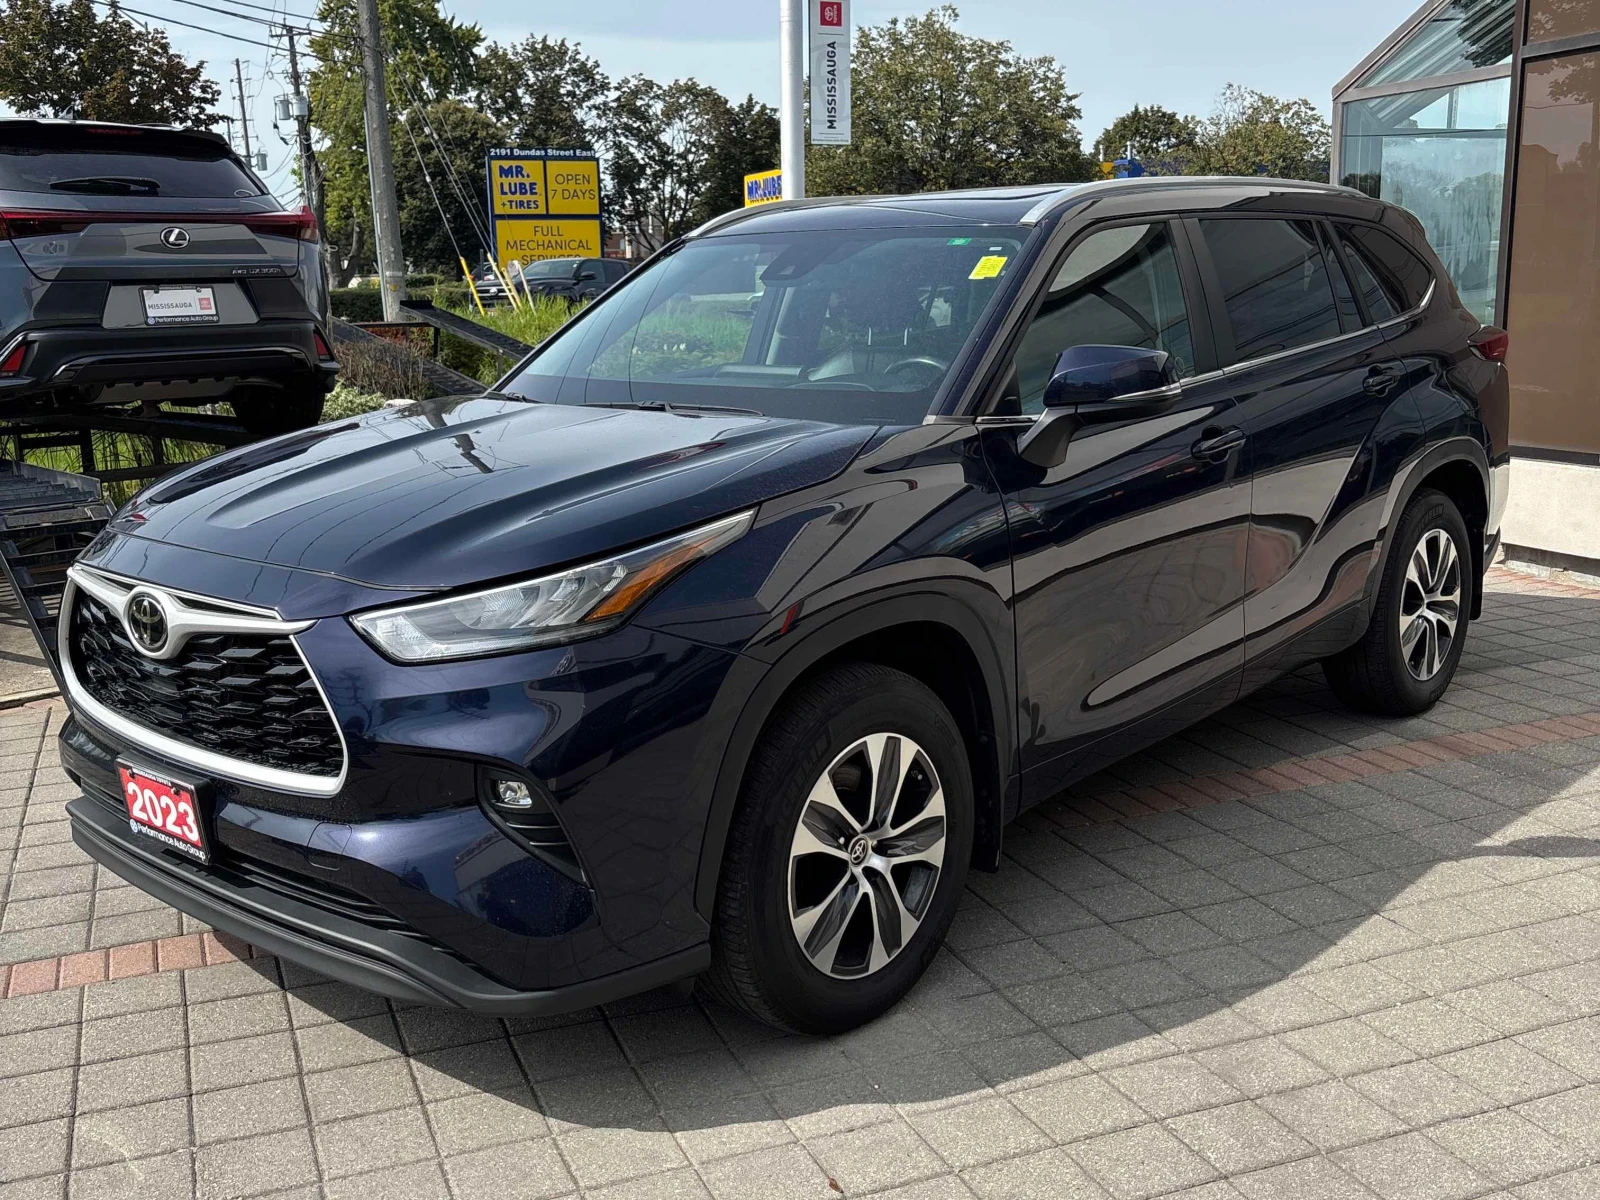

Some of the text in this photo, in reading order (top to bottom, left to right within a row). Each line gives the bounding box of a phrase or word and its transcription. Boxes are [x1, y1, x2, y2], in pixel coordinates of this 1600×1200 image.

[826, 41, 837, 130] MISSISSAUGA
[490, 148, 511, 156] 2191
[513, 148, 545, 156] Dundas
[576, 149, 595, 157] East
[498, 165, 530, 179] MR.
[554, 173, 591, 185] OPEN
[500, 182, 538, 196] LUBE
[551, 189, 596, 200] 7 DAYS
[533, 226, 564, 237] FULL
[506, 240, 592, 251] MECHANICAL
[148, 302, 193, 310] MISSISSAUGA
[127, 782, 199, 842] 2023
[137, 822, 206, 861] Performance Auto Group
